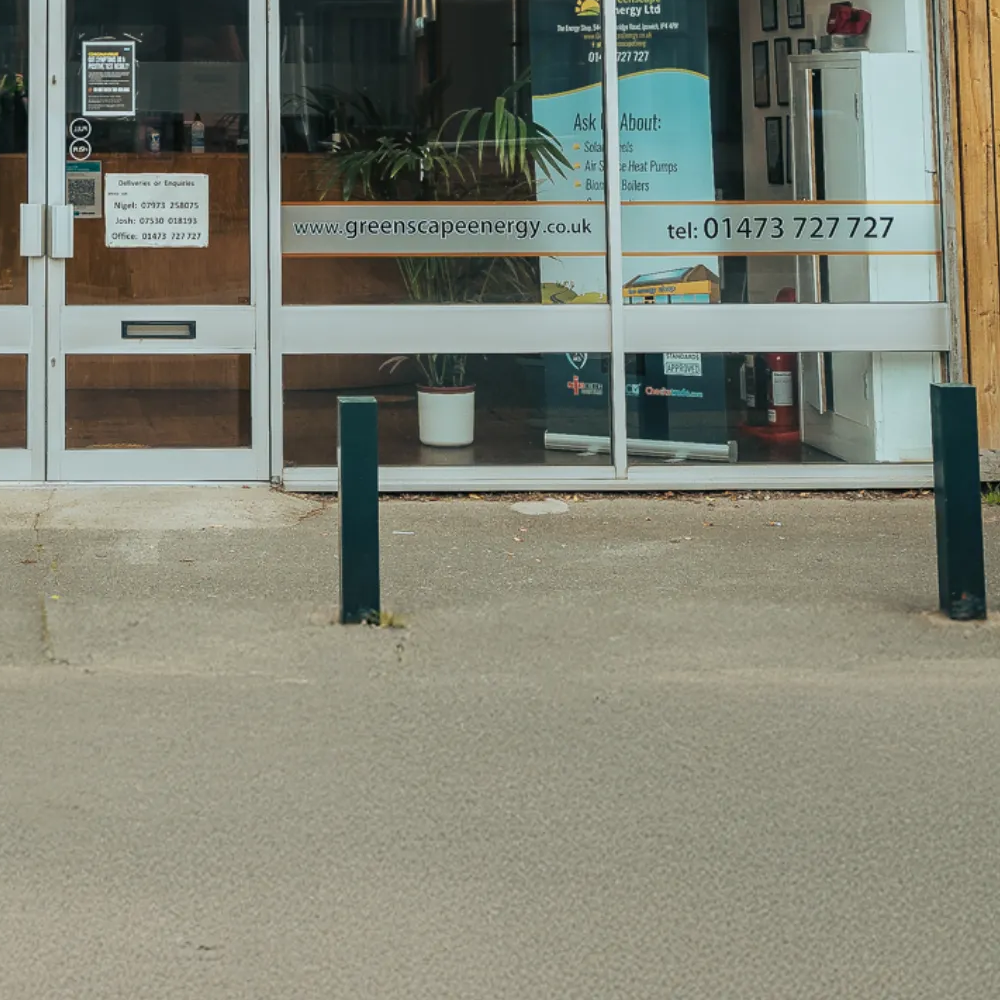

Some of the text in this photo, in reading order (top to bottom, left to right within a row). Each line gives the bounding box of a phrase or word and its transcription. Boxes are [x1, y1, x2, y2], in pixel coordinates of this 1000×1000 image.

[613, 4, 661, 17] nergy Ltd
[633, 51, 650, 62] 727
[573, 112, 597, 132] Ask
[620, 112, 661, 132] About:
[584, 140, 604, 153] Sola
[584, 160, 597, 172] Air
[628, 160, 648, 172] Heat
[650, 160, 679, 174] Pumps
[118, 179, 151, 187] Deliveries
[164, 179, 195, 188] Enquiries
[621, 179, 650, 192] Boilers
[113, 201, 138, 211] Nigel:
[115, 217, 137, 225] Josh:
[667, 216, 895, 239] tel: 01473 727 727
[293, 217, 592, 239] www.greenscapeenergy.co.uk
[111, 232, 138, 240] Office:
[141, 232, 167, 240] 01473
[666, 362, 700, 375] APPROVED
